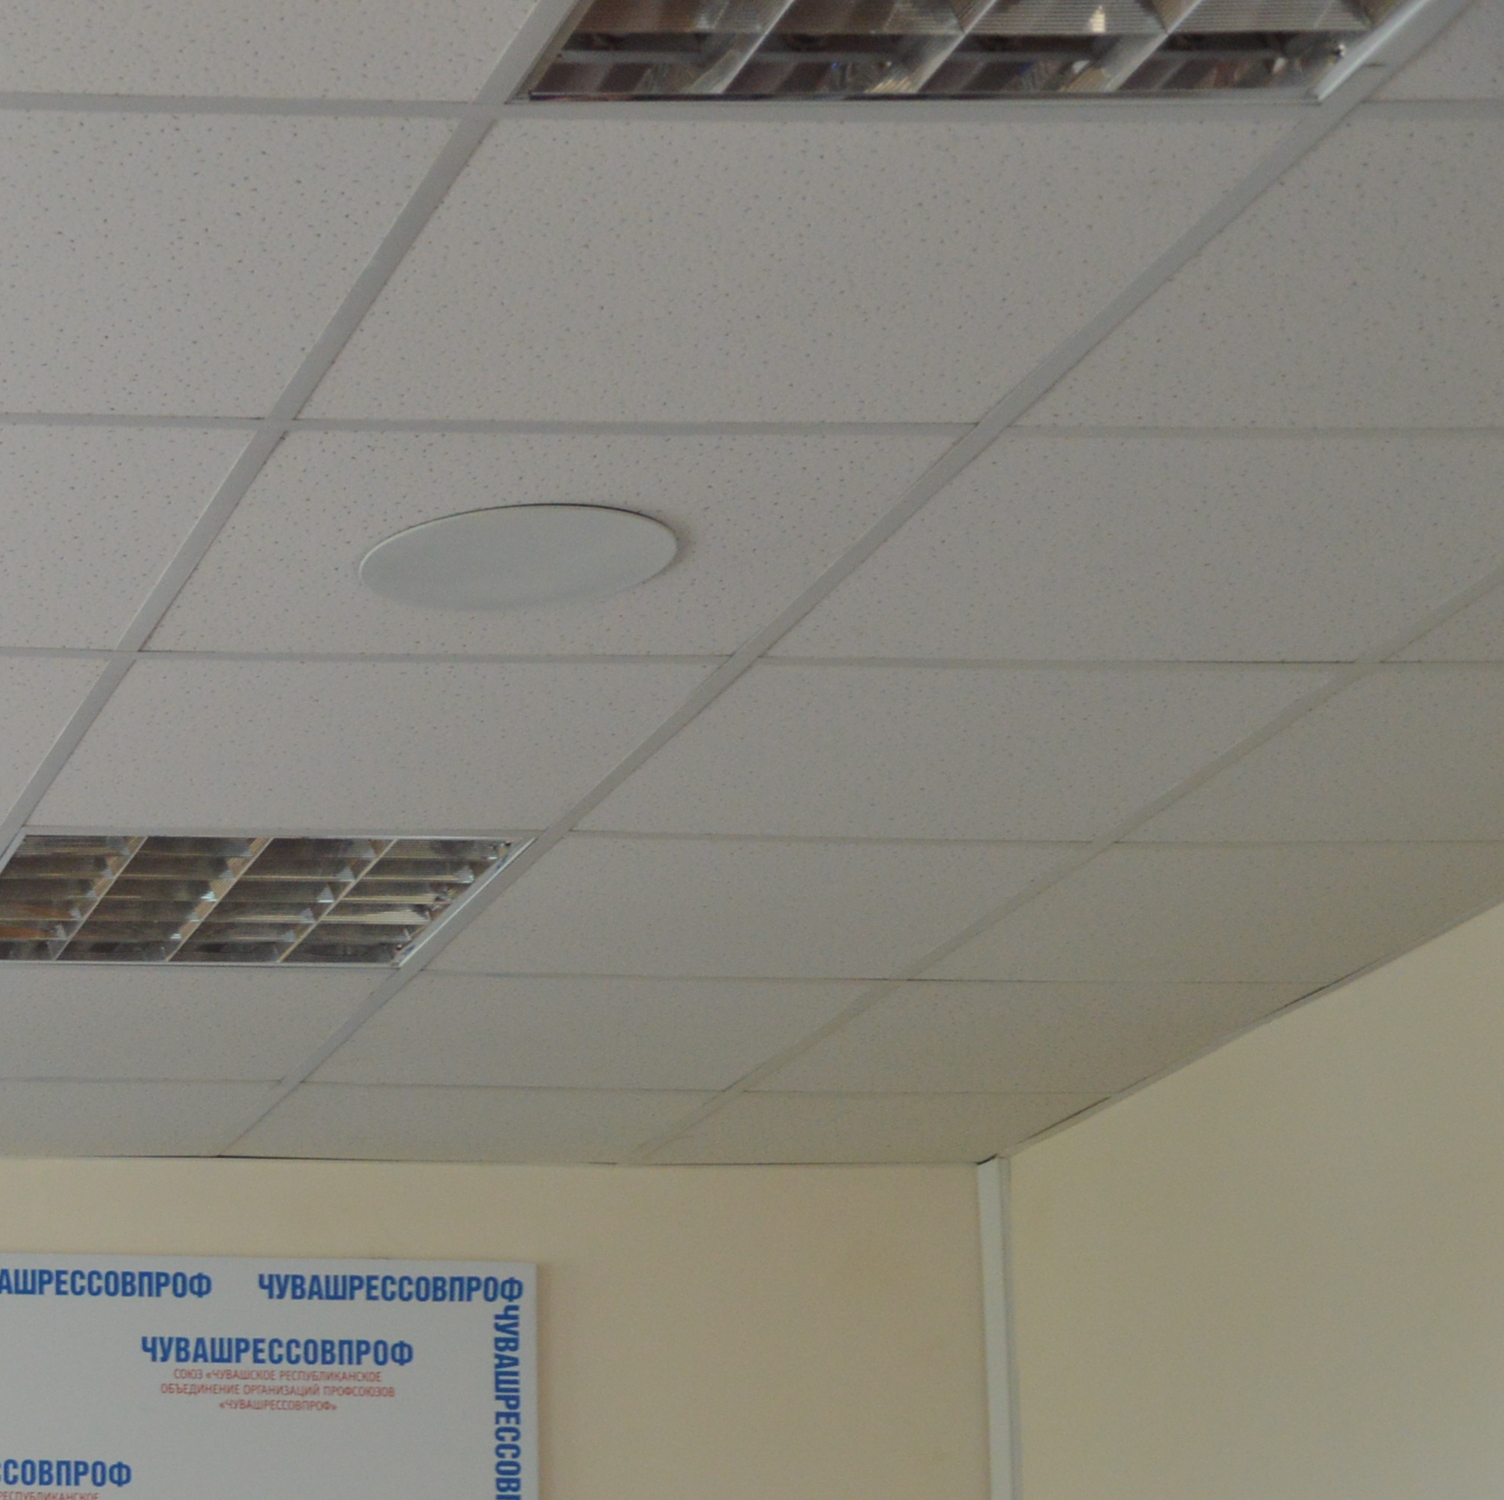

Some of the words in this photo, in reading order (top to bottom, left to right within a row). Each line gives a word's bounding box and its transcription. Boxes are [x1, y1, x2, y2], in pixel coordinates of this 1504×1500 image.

[259, 1274, 524, 1304] ЧУВАШРЕССОВПРОФ
[141, 1336, 414, 1366] ЧУВАШРЕССОВПРОФ
[174, 1368, 204, 1380] СОЮЗ
[206, 1369, 277, 1381] «ЧУВАШСКОЕ
[280, 1370, 383, 1383] РЕСПУБЛИКАНСКОЕ
[161, 1382, 240, 1396] ОБЪЕДИНЕНИЕ
[243, 1383, 320, 1397] ОРГАНИЗАЦИЙ
[323, 1384, 396, 1398] ПРОФСОЮЗОВ
[219, 1400, 338, 1410] «ЧУВАШРЕССОВПРОФ»
